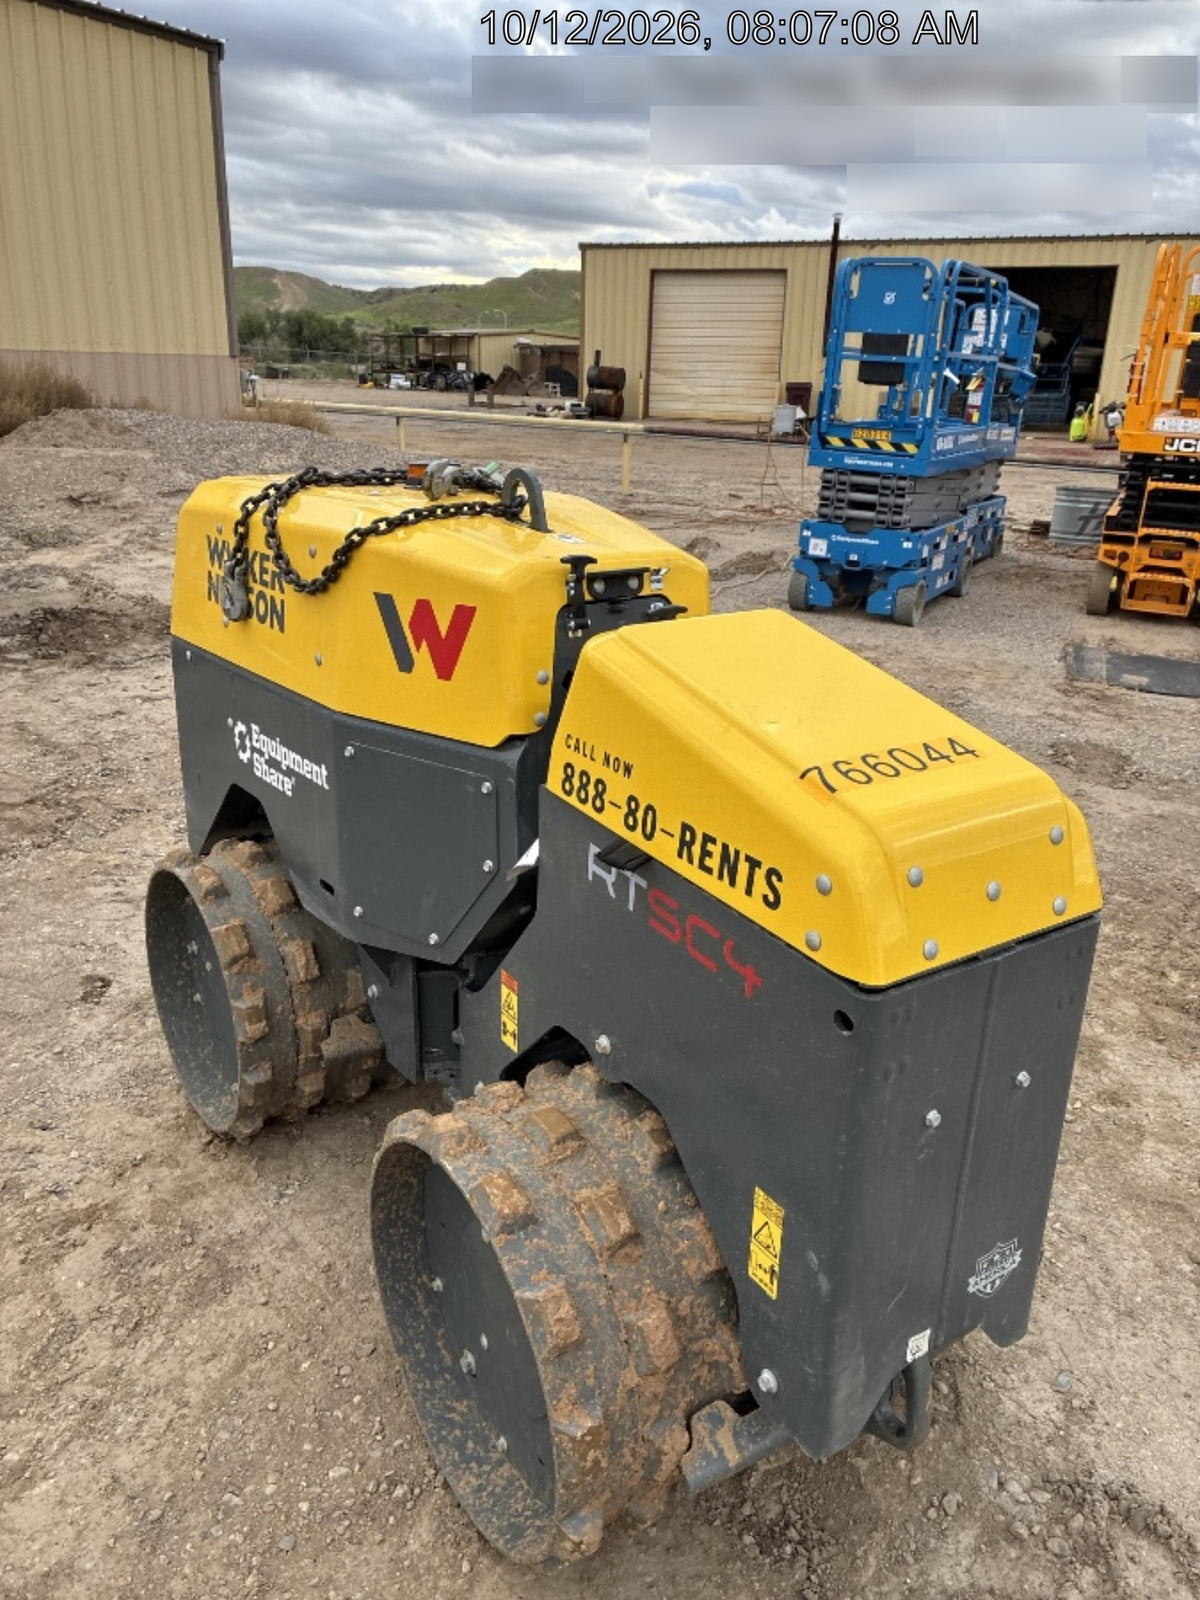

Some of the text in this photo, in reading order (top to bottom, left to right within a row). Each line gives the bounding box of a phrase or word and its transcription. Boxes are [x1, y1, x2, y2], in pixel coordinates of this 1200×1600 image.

[1164, 438, 1200, 453] JC
[250, 723, 329, 790] Equipment
[565, 733, 634, 779] CALL NOW
[800, 737, 980, 795] 766044
[560, 761, 784, 911] 888-80-RENTS
